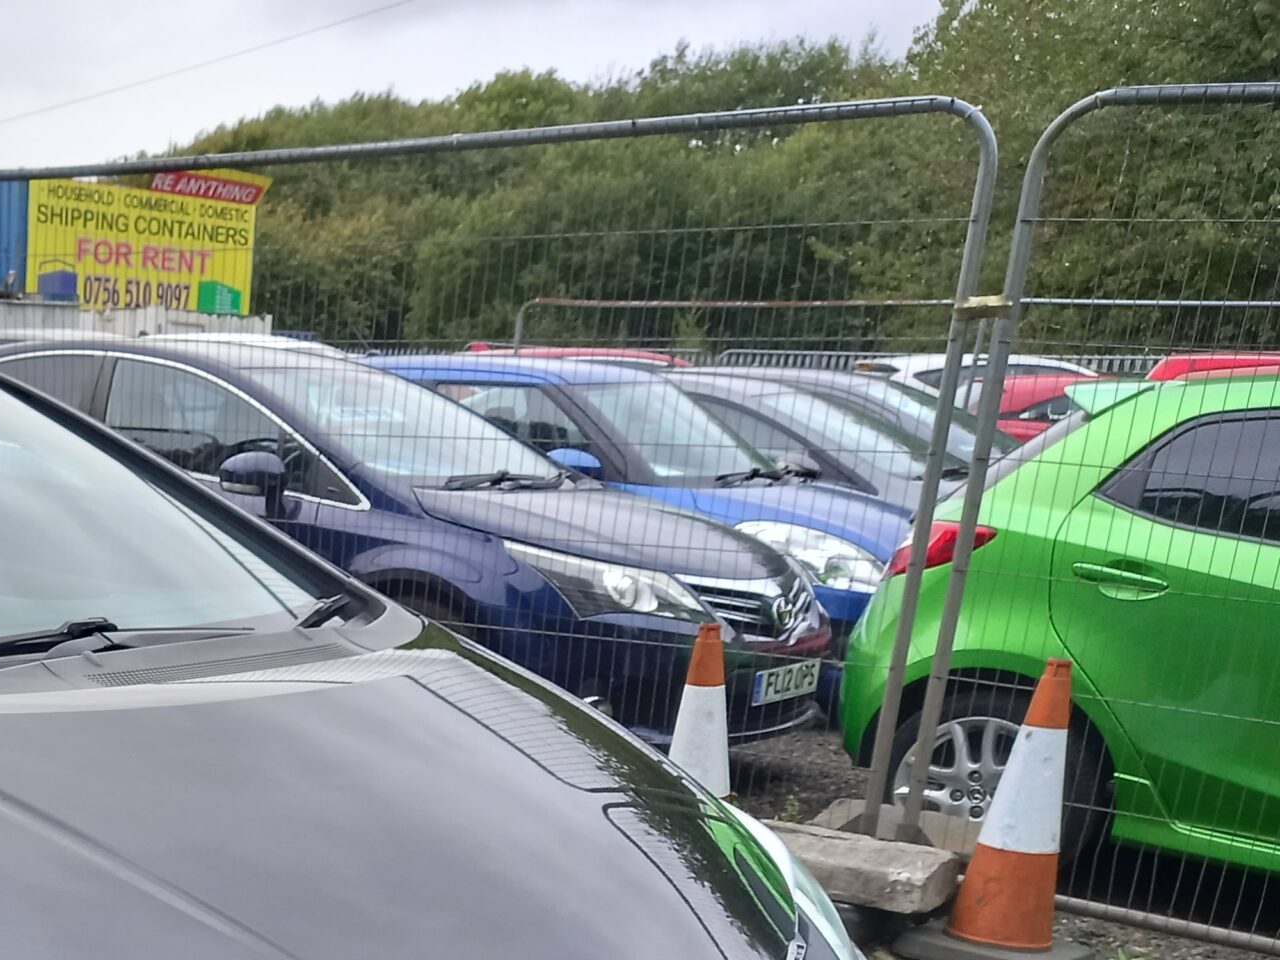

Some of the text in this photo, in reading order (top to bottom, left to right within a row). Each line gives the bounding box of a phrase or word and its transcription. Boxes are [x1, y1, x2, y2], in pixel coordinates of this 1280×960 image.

[48, 185, 249, 222] HOUSEHOLD COMMERCIAL DOMESTIC
[176, 177, 256, 203] ANYTHING
[36, 204, 249, 246] SHIPPING CONTAINERS
[76, 238, 211, 274] FOR RENT
[83, 275, 120, 306] 0756
[124, 279, 152, 308] 510
[157, 282, 191, 310] 9097
[765, 669, 793, 698] FL12
